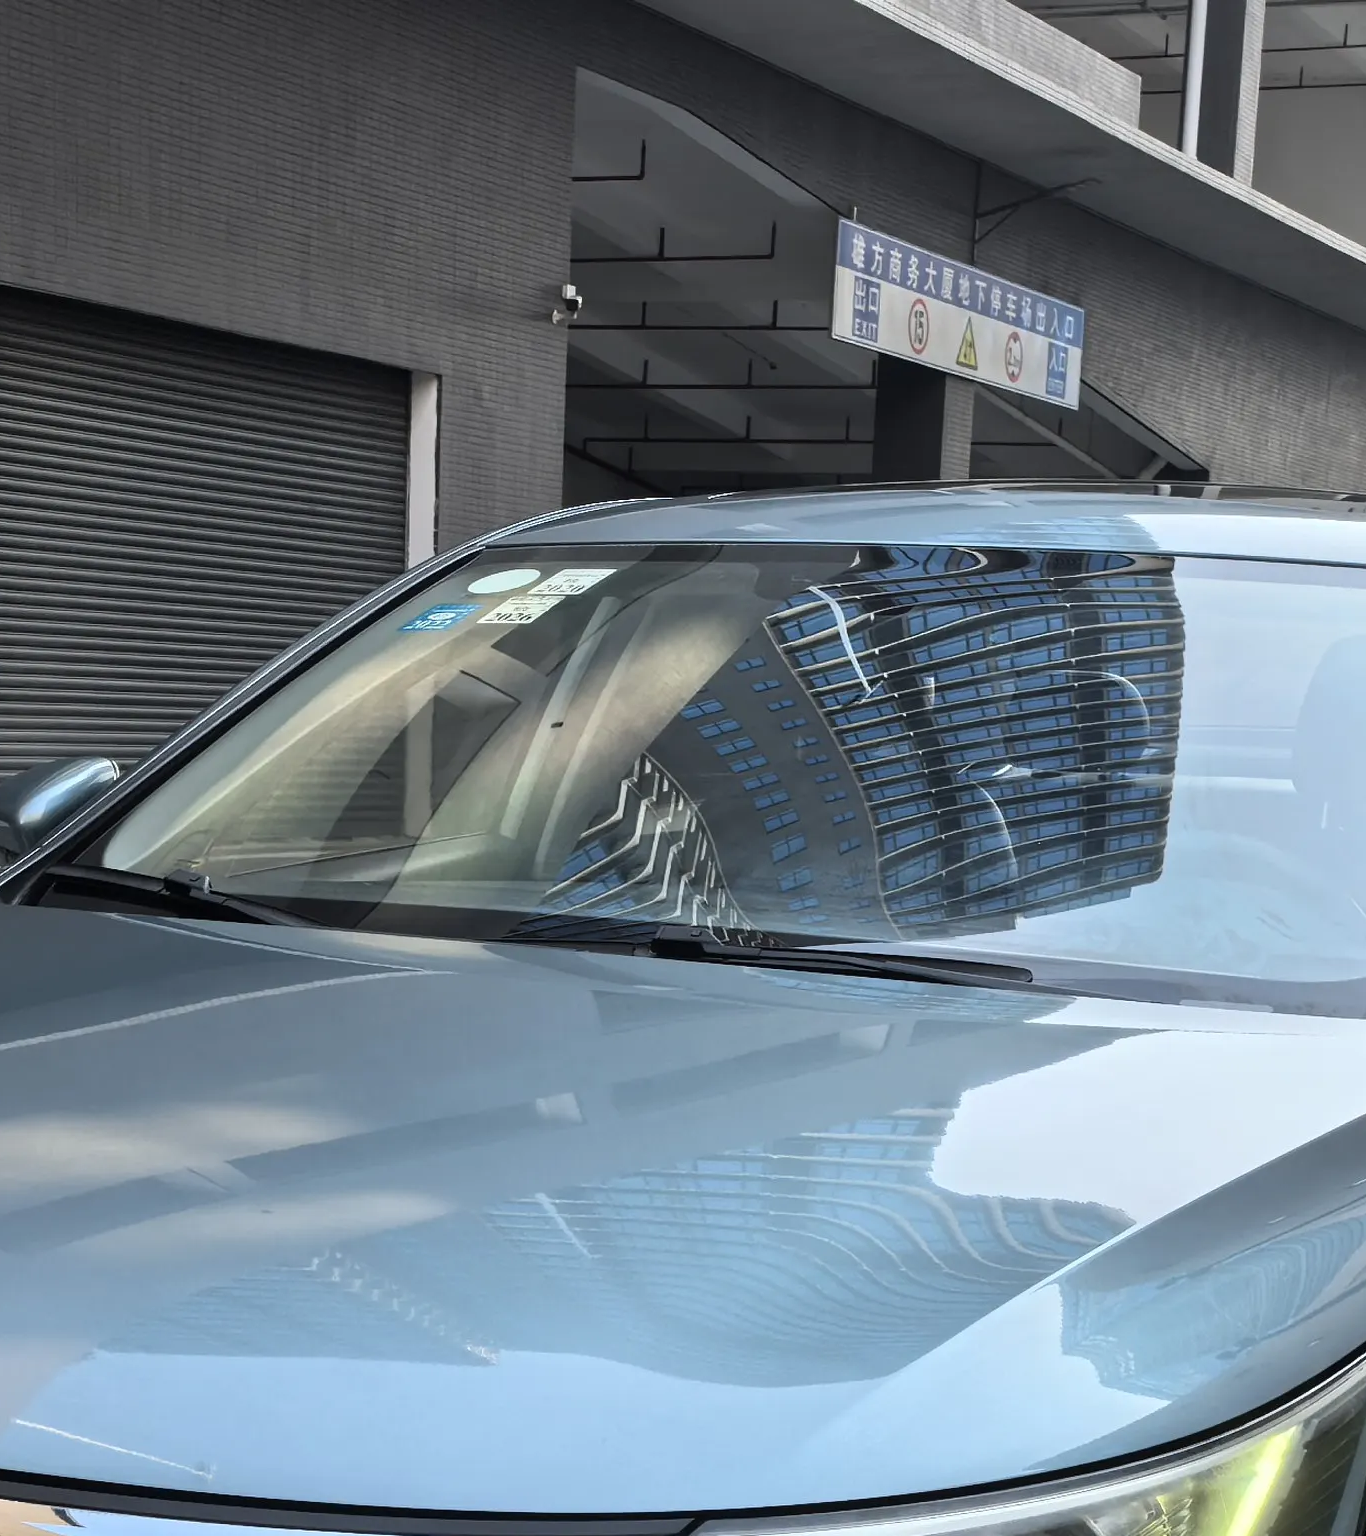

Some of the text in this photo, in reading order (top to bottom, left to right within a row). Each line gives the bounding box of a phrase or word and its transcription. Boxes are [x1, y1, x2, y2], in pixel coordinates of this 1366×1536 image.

[854, 279, 880, 315] 出口
[854, 318, 878, 341] EXIT
[1049, 347, 1066, 373] 入口
